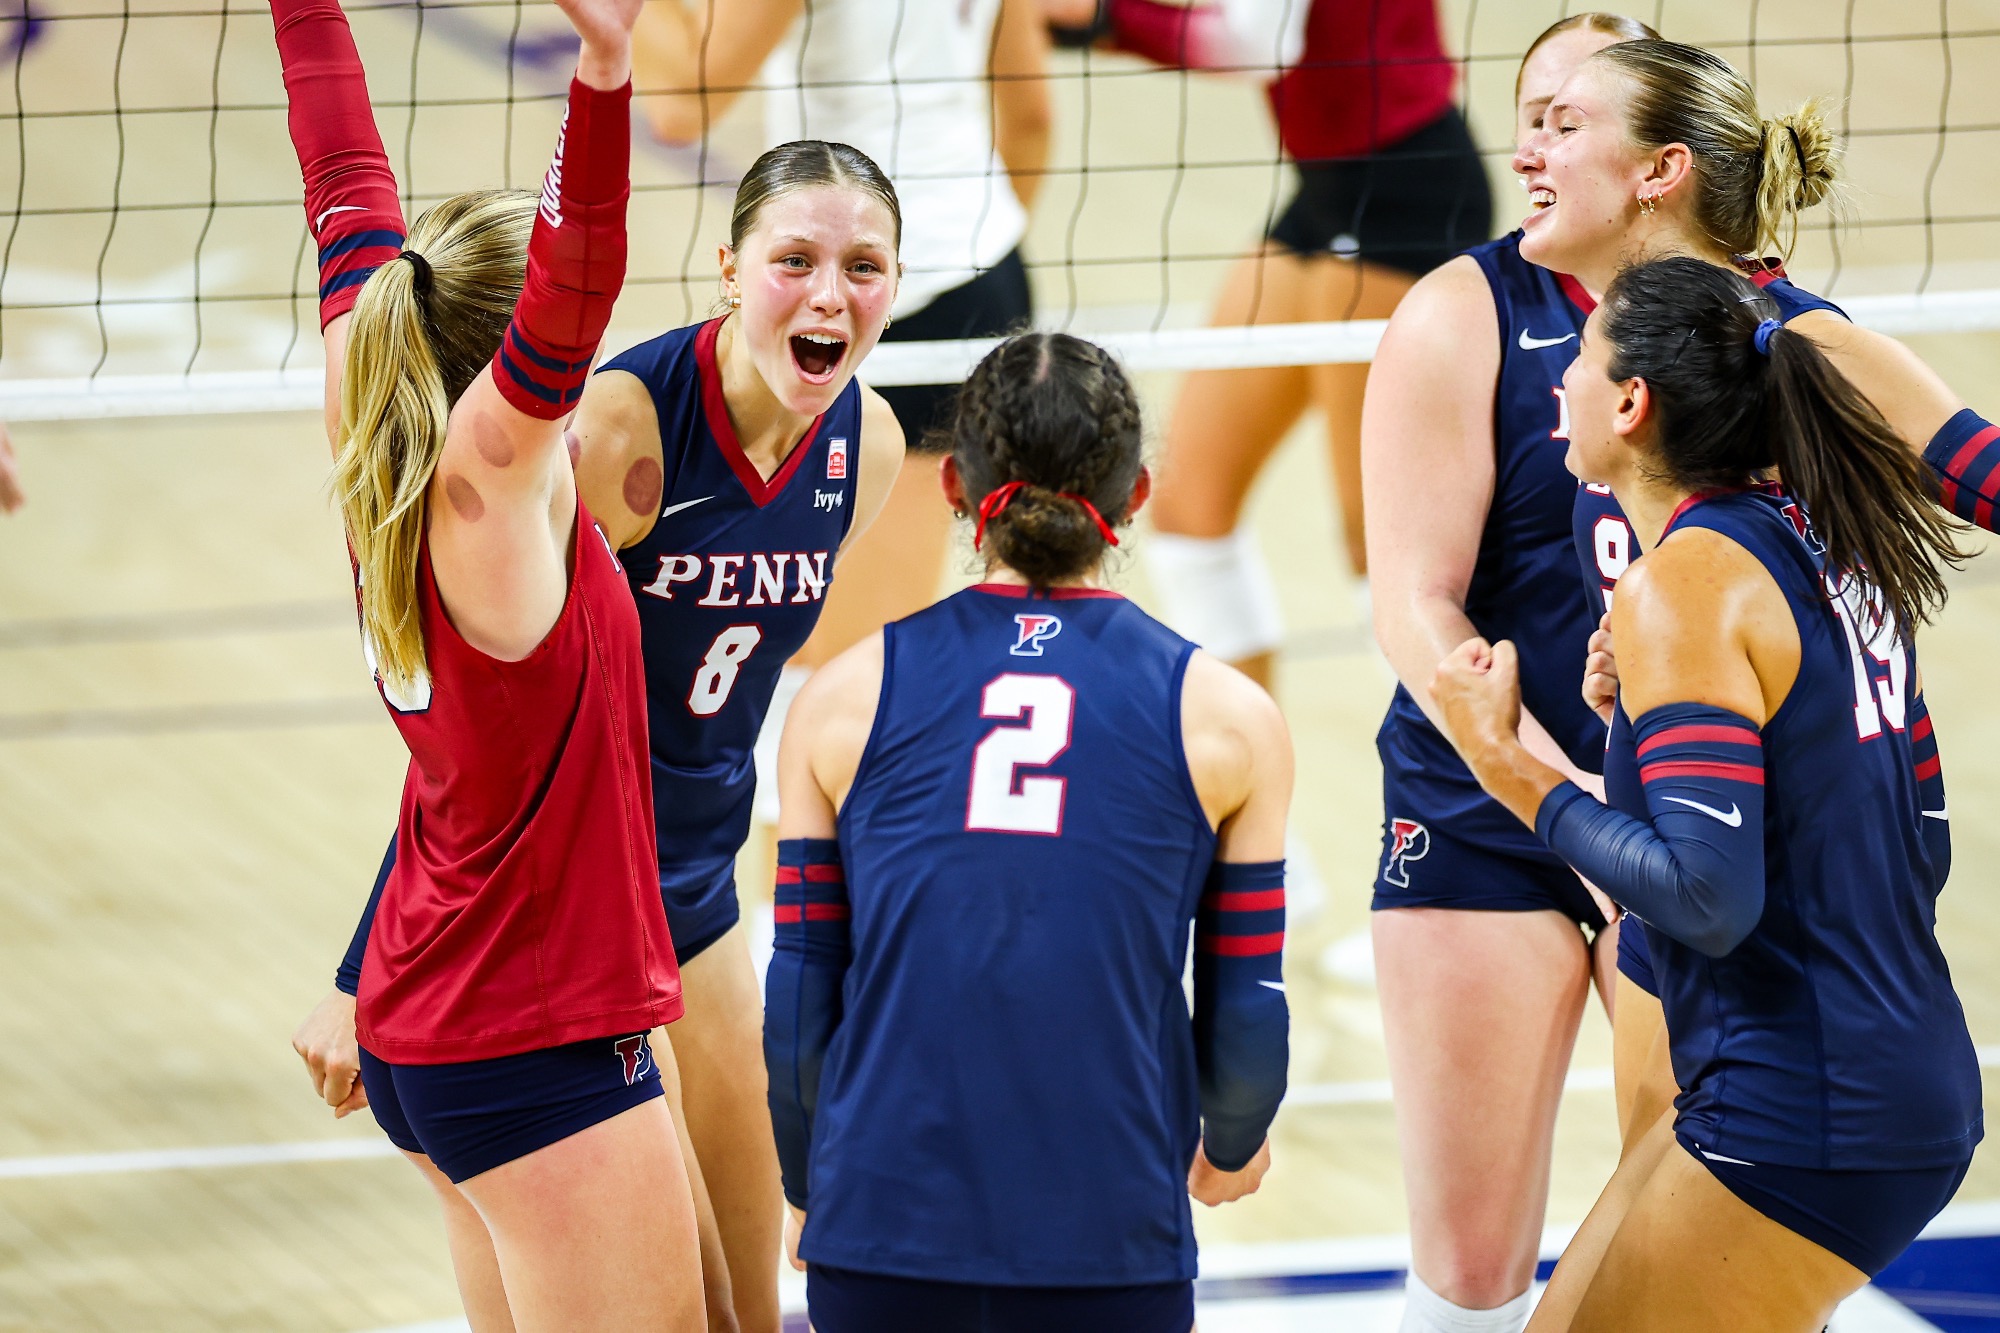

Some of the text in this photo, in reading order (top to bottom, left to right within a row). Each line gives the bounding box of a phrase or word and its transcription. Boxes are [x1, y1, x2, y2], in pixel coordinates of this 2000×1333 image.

[814, 489, 836, 512] Ivy
[641, 551, 828, 607] PENN
[688, 622, 763, 719] 8
[1009, 613, 1062, 656] P
[1819, 564, 1907, 743] 19
[965, 672, 1076, 837] 2
[1383, 817, 1430, 889] P
